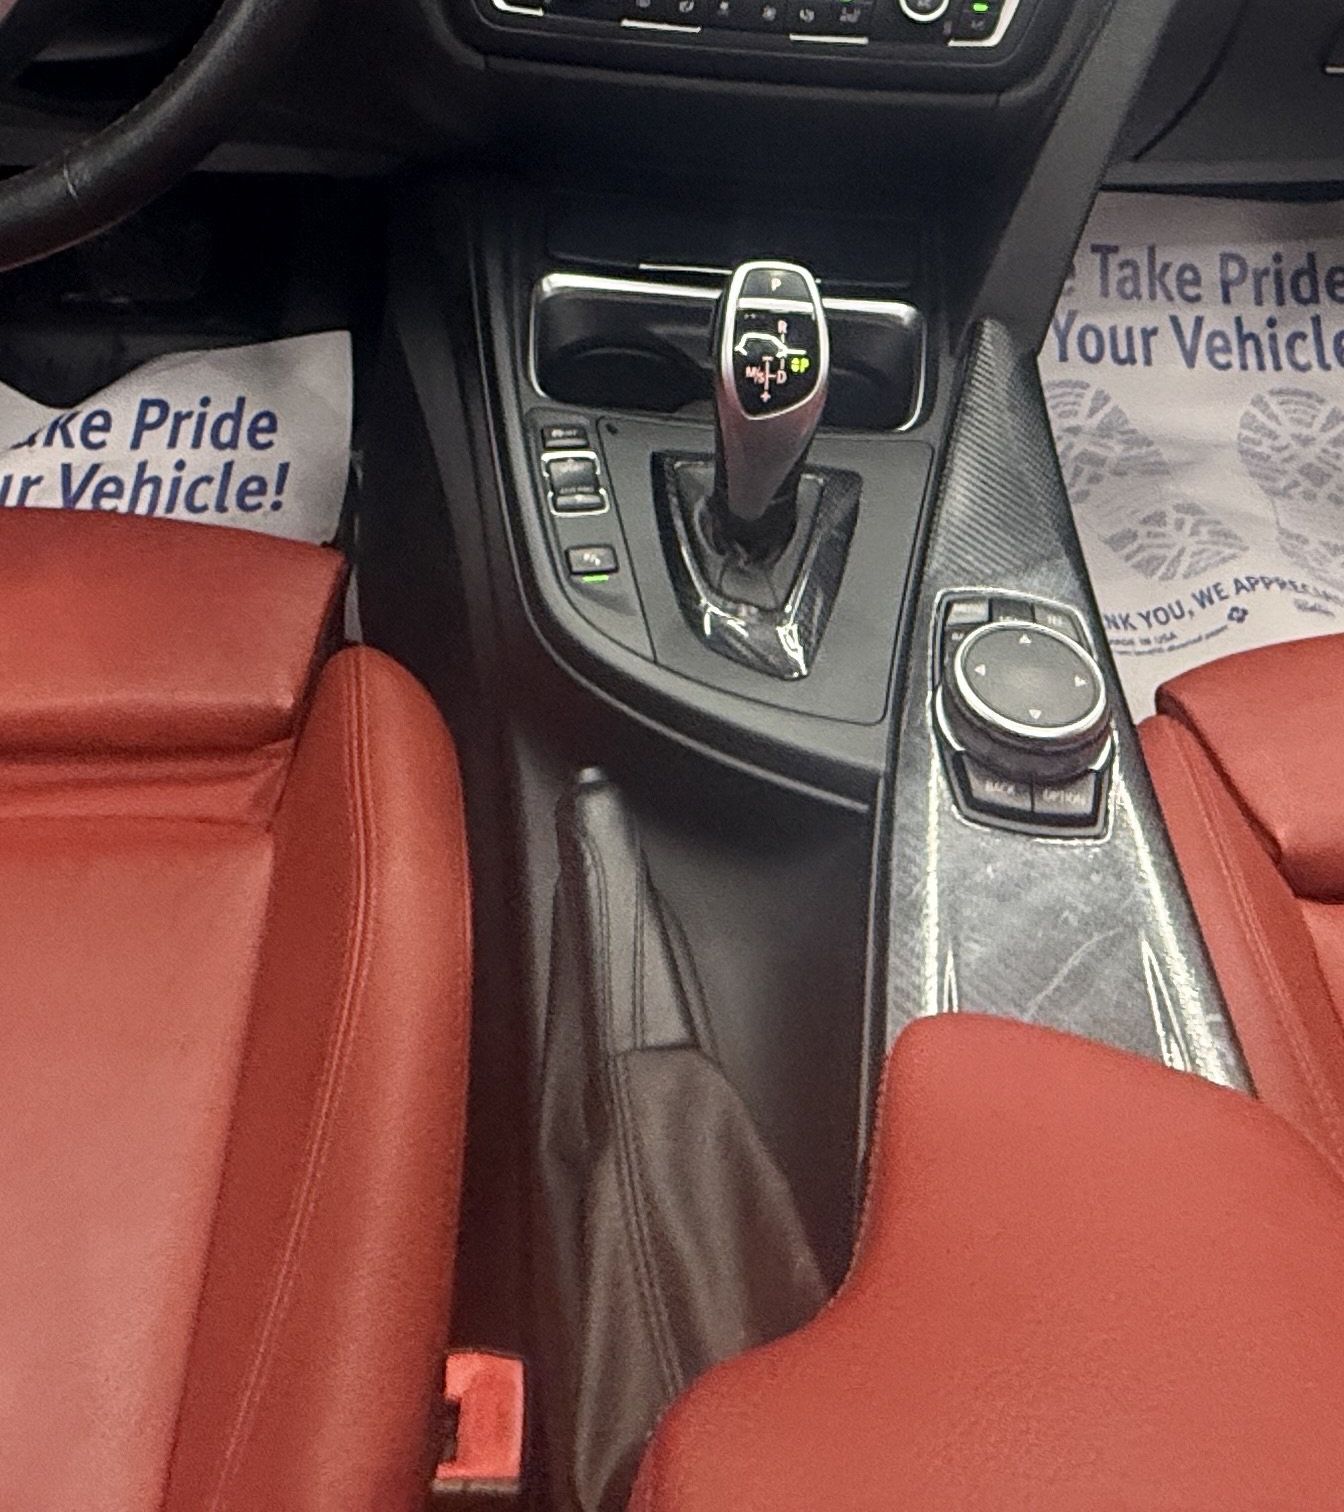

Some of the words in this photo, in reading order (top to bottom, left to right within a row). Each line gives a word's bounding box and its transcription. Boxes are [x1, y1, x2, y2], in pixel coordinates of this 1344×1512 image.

[771, 278, 782, 292] P
[1090, 243, 1203, 303] Take
[777, 320, 788, 334] R
[1052, 309, 1159, 367] Your
[776, 370, 787, 384] D
[11, 408, 111, 451] ke
[131, 395, 278, 451] Pride
[58, 459, 292, 515] Vehicle!
[1103, 612, 1138, 631] NK
[1138, 599, 1195, 627] YOU,
[1191, 581, 1230, 610] WE
